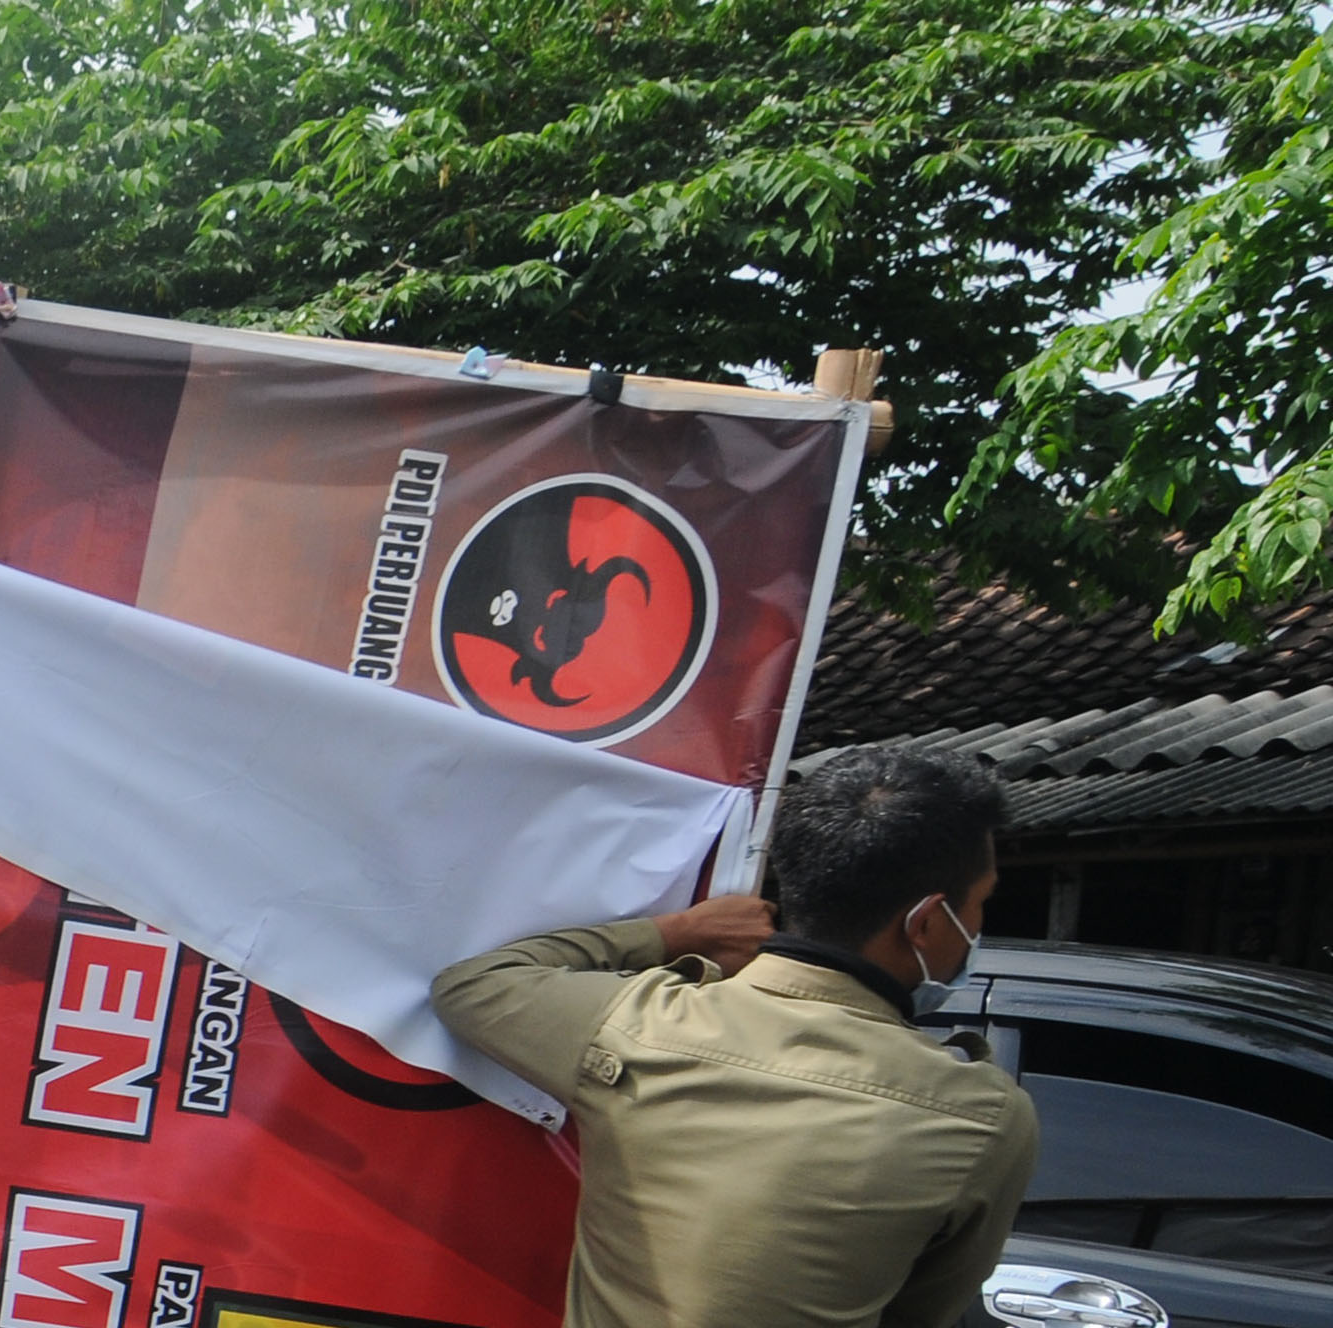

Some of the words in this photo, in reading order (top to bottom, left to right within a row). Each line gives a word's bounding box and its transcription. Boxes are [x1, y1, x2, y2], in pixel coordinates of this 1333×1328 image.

[389, 456, 442, 517] PDI
[33, 922, 175, 1132] EN
[186, 962, 245, 1108] NGAN
